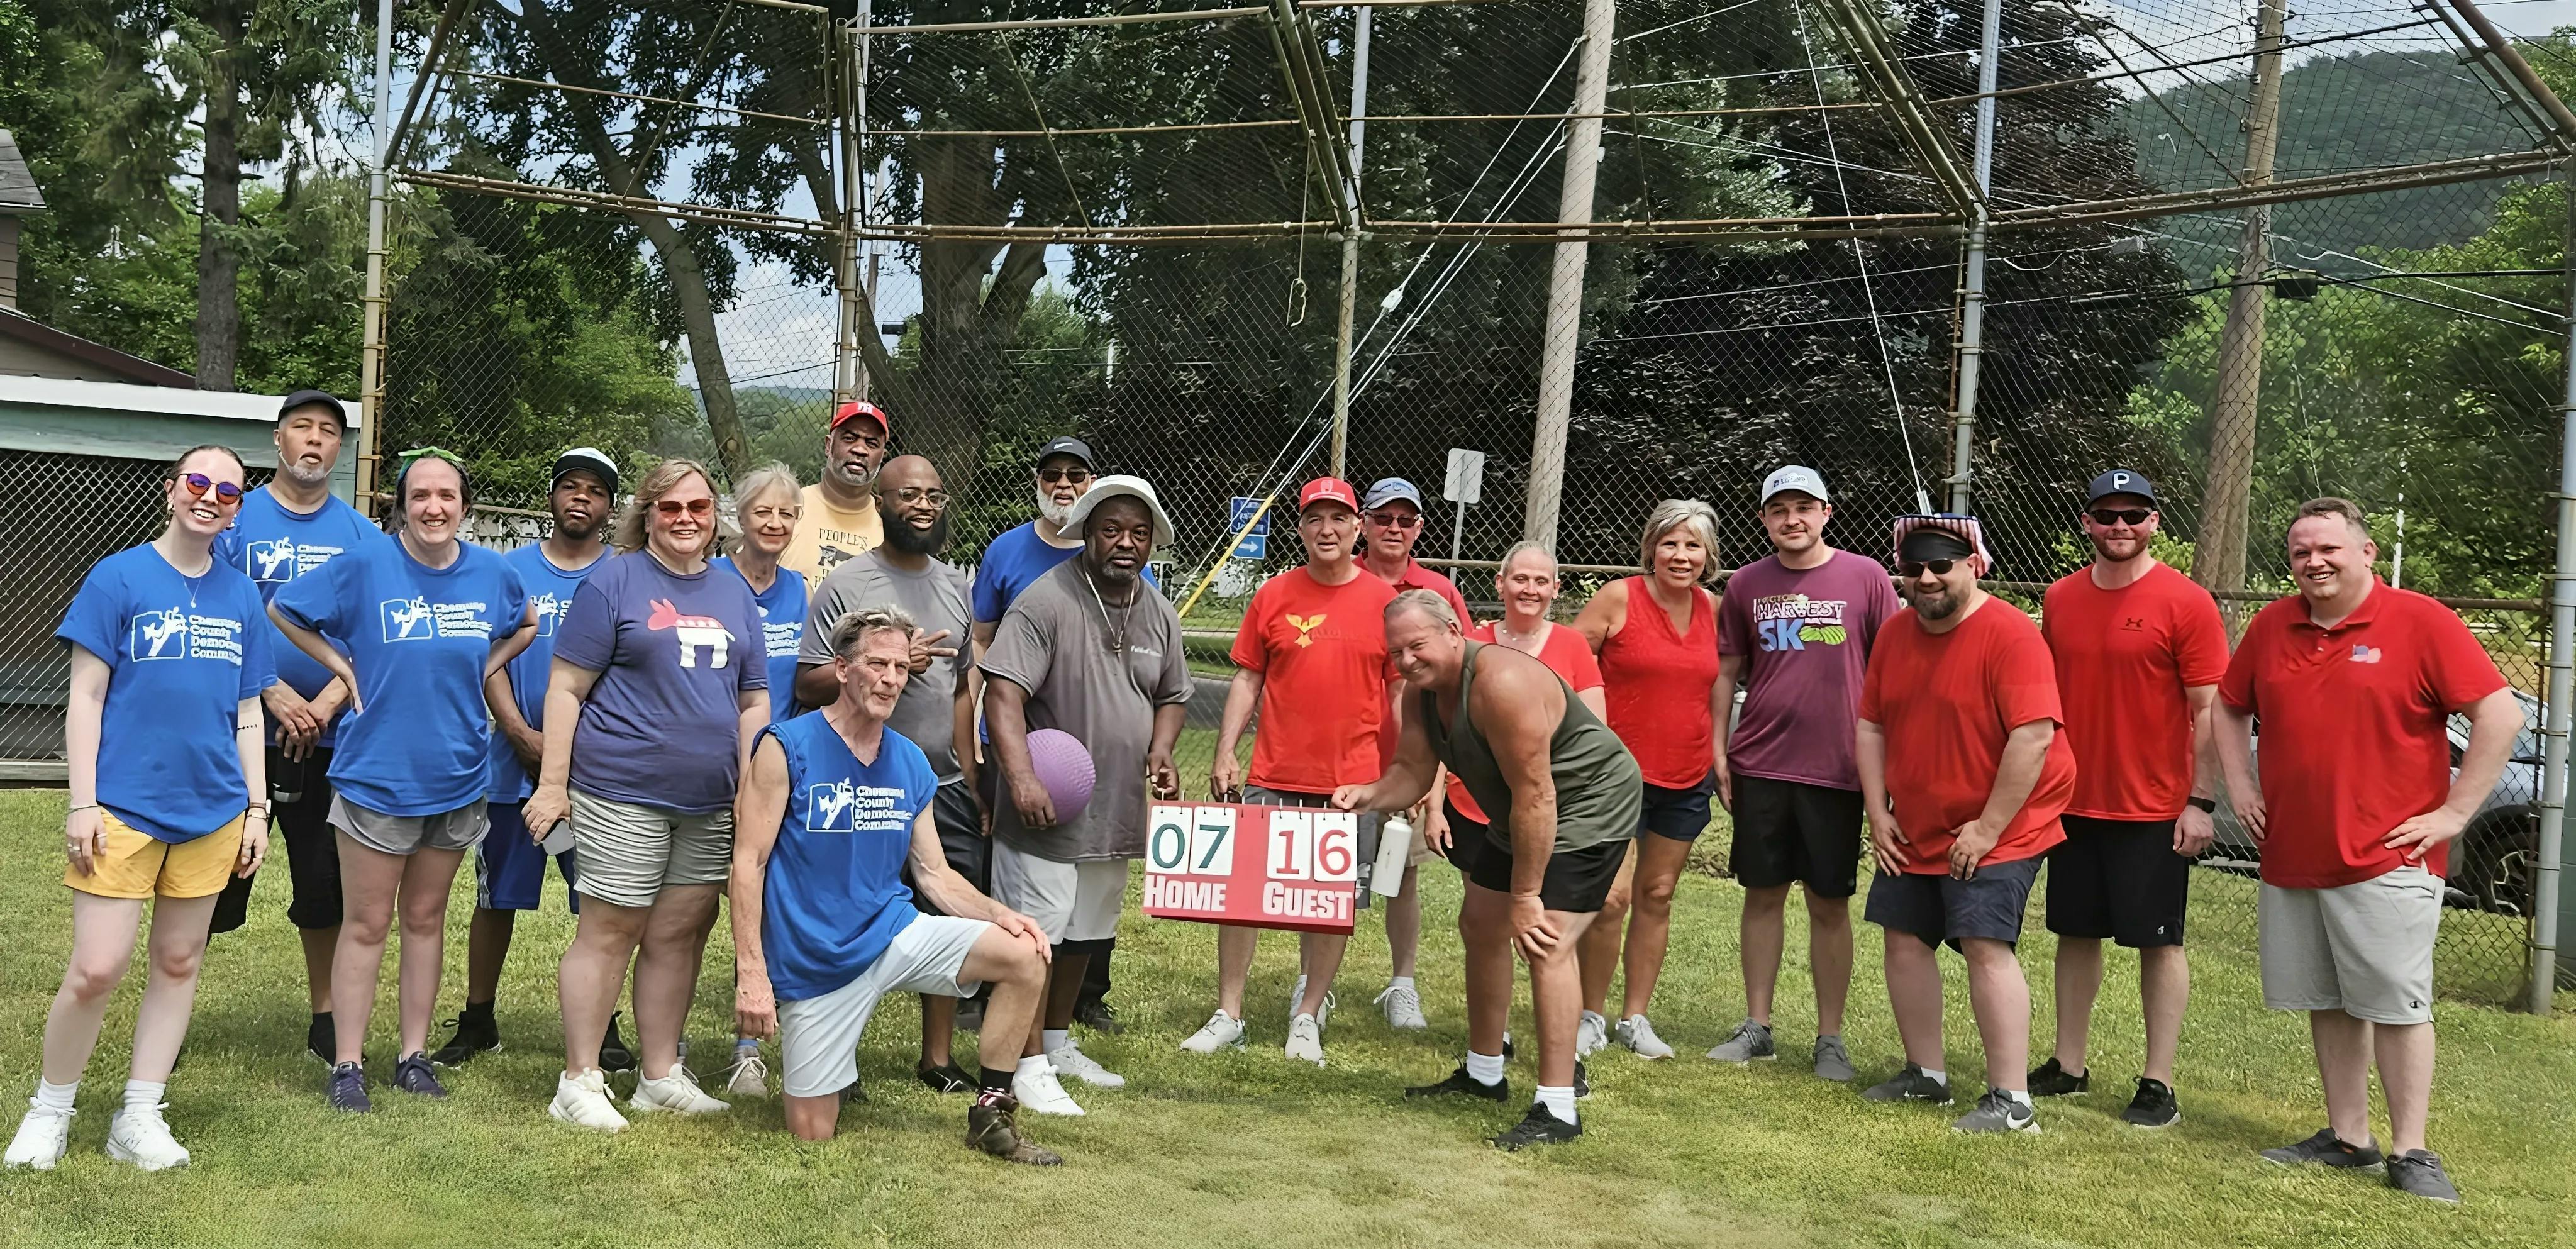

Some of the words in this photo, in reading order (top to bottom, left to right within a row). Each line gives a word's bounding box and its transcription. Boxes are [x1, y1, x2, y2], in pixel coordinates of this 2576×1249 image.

[2113, 472, 2130, 490] P
[1757, 600, 1847, 621] HARVEST
[189, 624, 231, 641] County
[1758, 618, 1806, 652] 5K
[855, 796, 895, 809] County
[1143, 874, 1226, 912] HOME
[1262, 882, 1353, 920] GUEST
